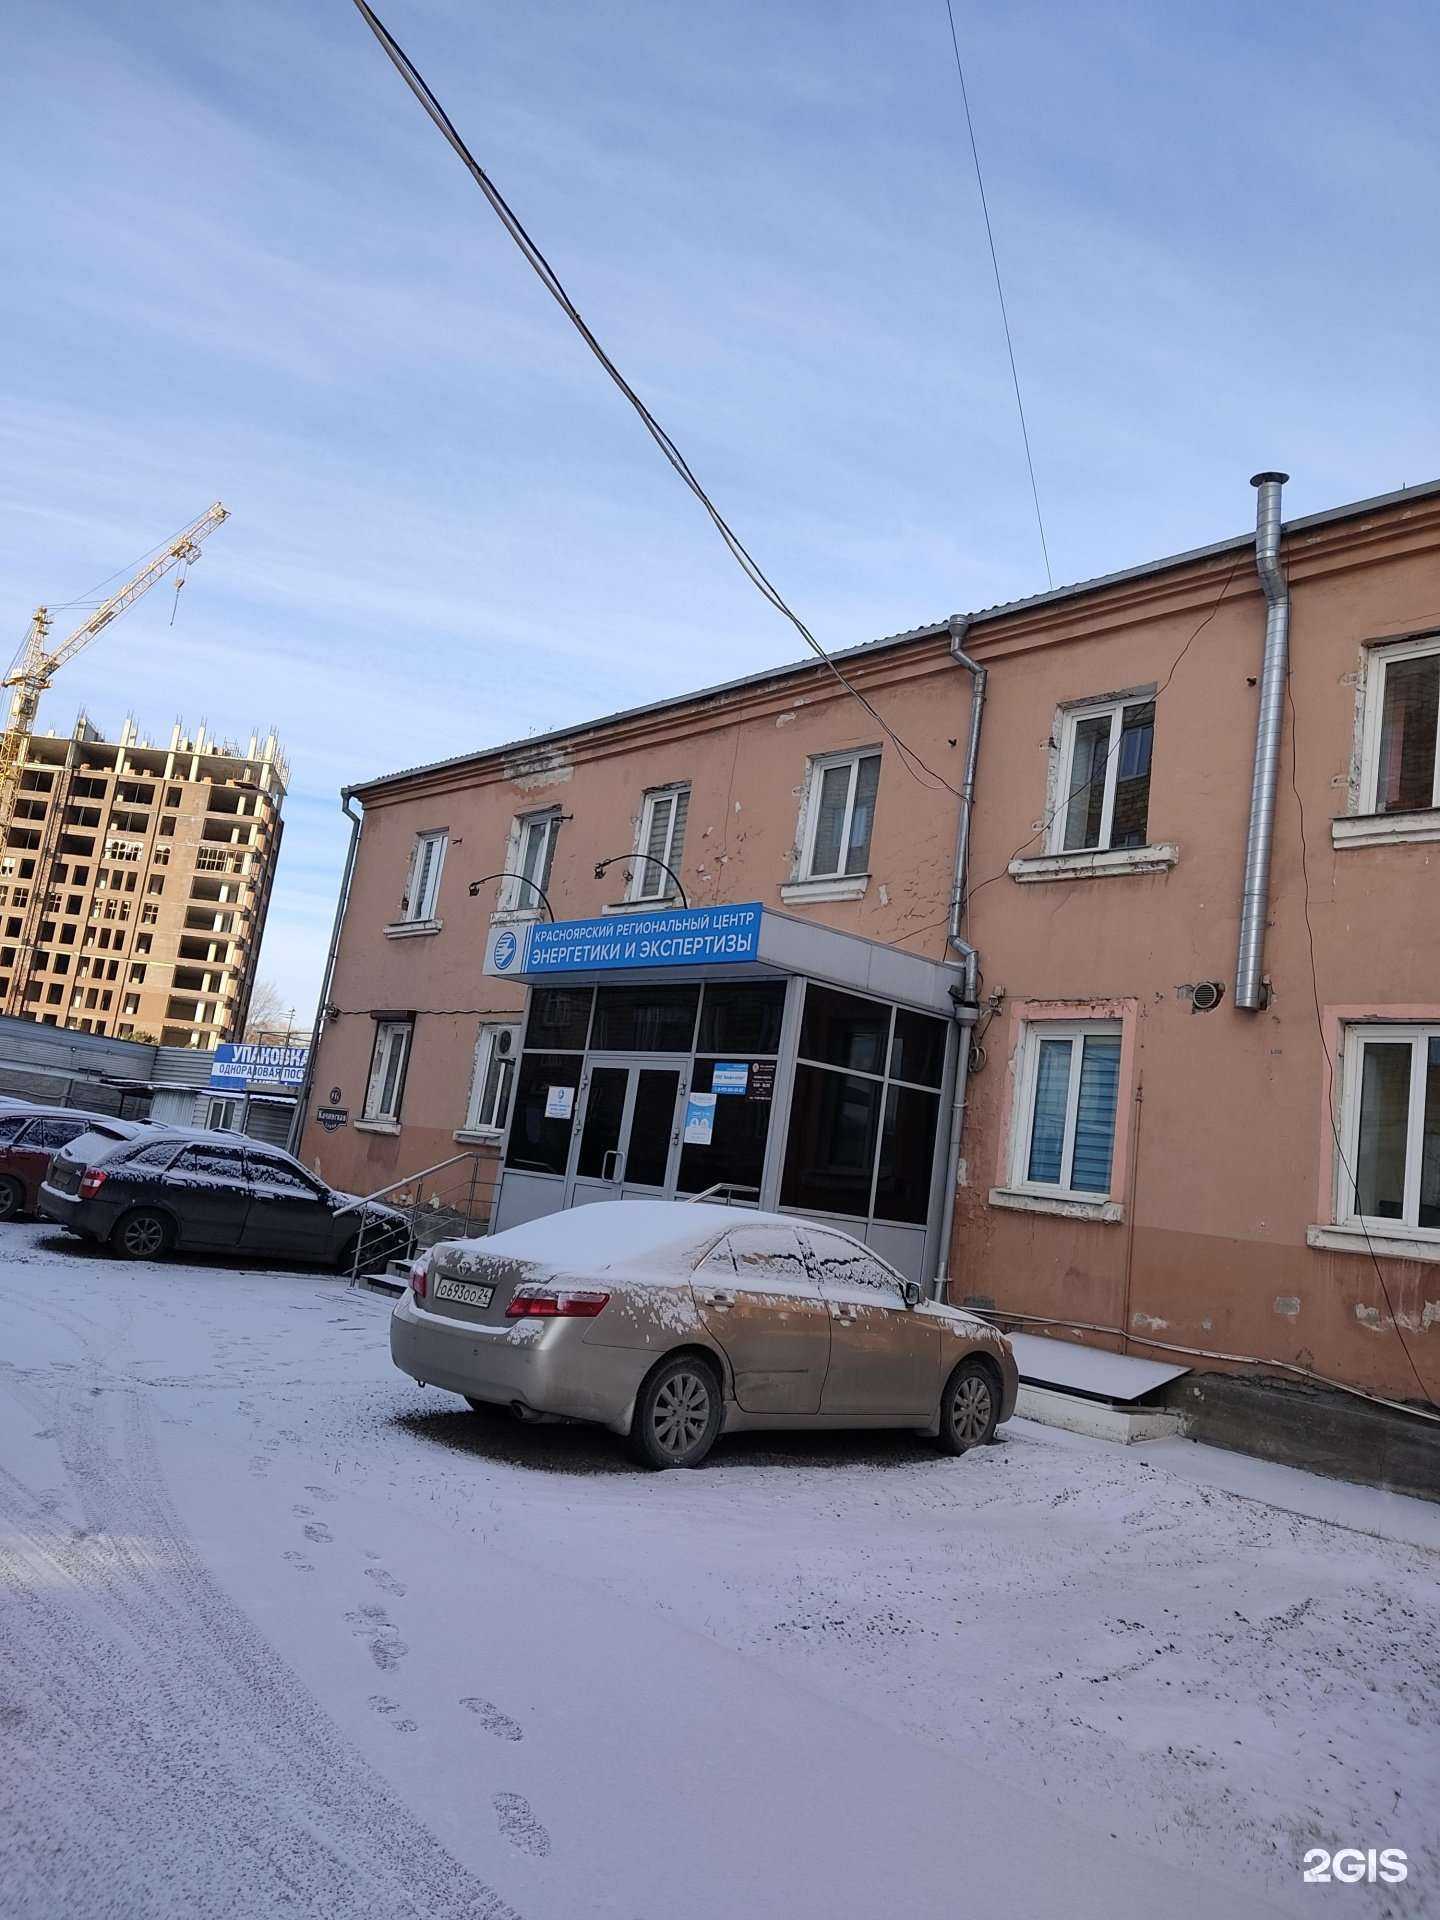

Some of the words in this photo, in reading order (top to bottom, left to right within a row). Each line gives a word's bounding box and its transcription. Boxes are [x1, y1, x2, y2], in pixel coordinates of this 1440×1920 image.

[535, 923, 614, 943] КРАСНОЯРСКИЙ
[616, 914, 710, 937] РЕГИОНАЛЬНЫЙ
[713, 911, 755, 930] ЦЕНТР
[531, 943, 620, 965] ЭНЕРГЕТИКИ
[624, 941, 637, 959] И
[640, 933, 752, 958] ЭКСПЕРТИЗЫ
[219, 1063, 281, 1080] ОДНОРАОВАЯ
